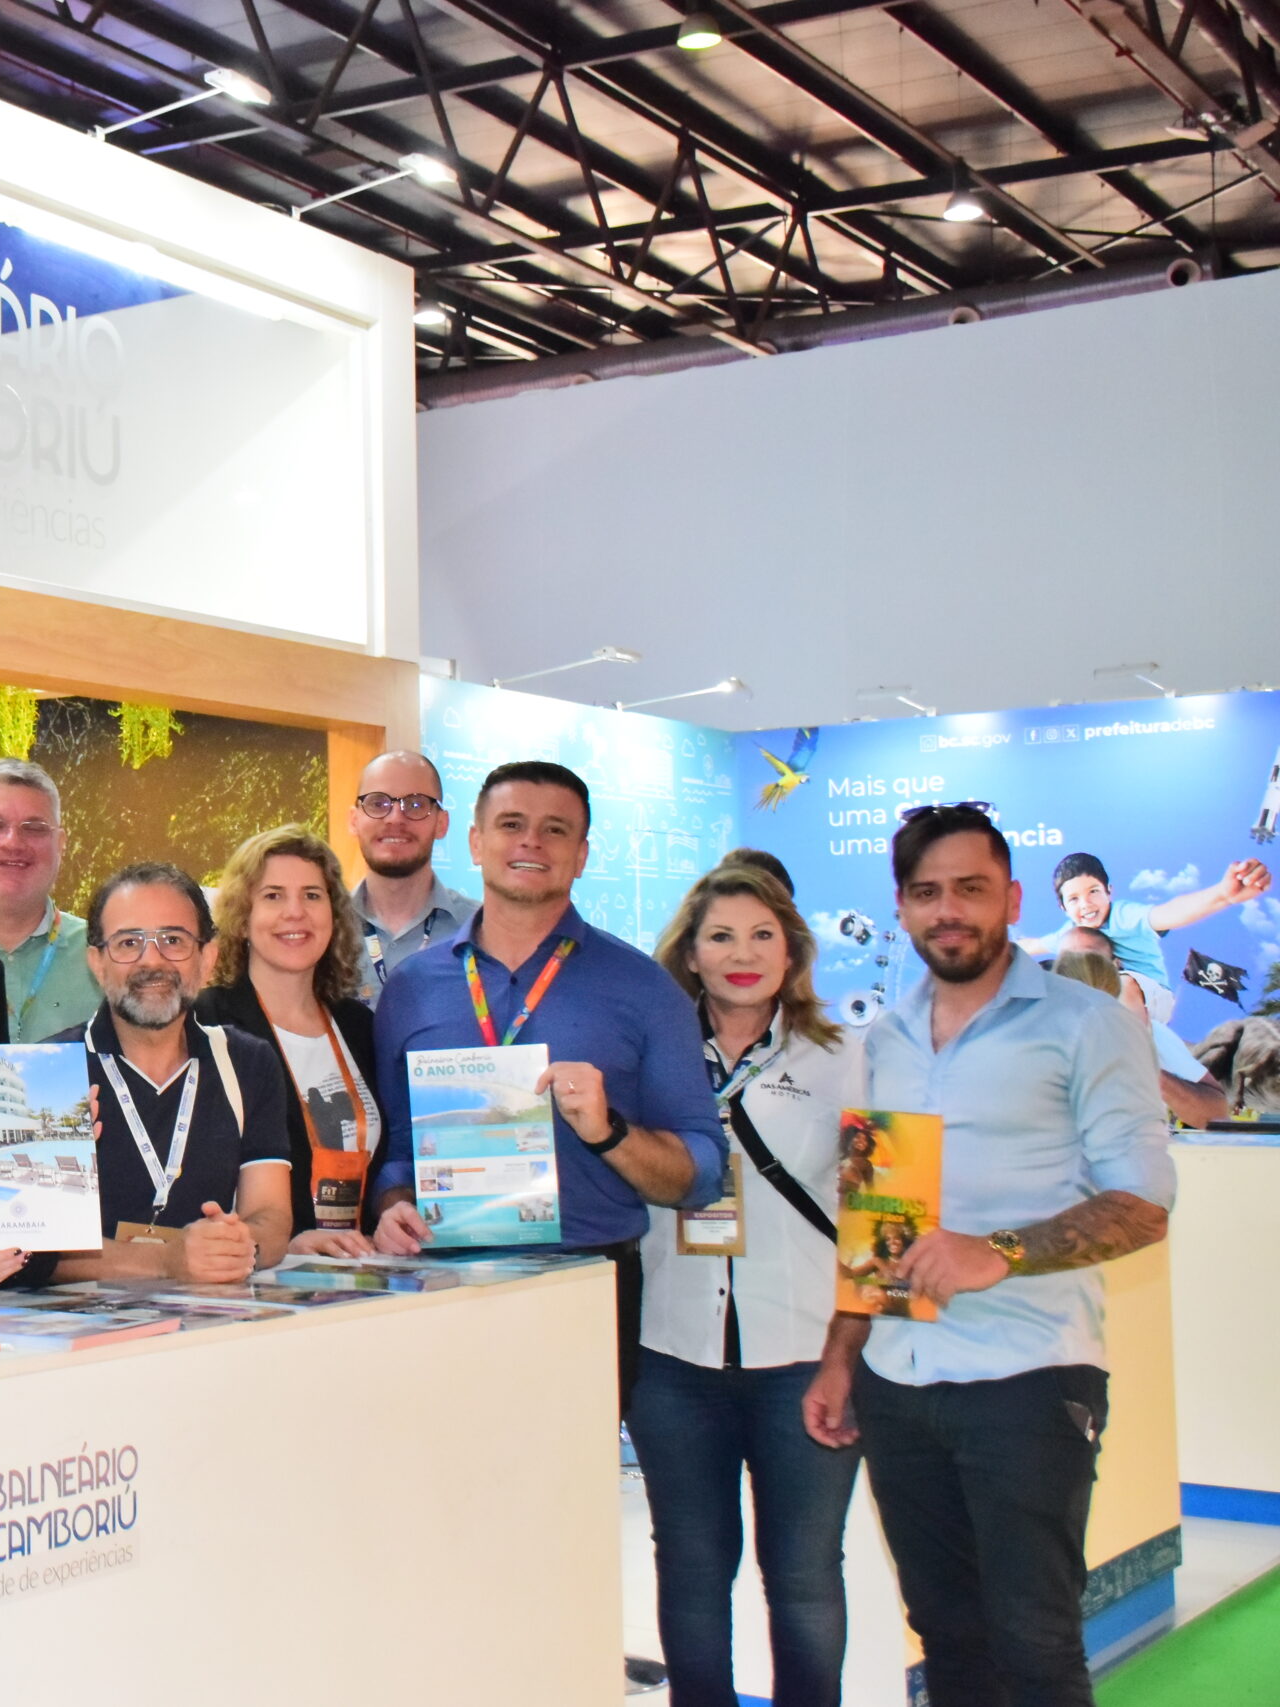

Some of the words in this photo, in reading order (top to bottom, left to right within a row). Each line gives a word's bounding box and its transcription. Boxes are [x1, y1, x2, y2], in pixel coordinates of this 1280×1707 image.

[1084, 716, 1216, 740] prefeituradebc
[828, 775, 887, 798] Mais
[892, 774, 945, 798] que
[828, 808, 887, 827] uma
[829, 837, 888, 856] uma
[413, 1066, 423, 1077] O
[426, 1065, 456, 1077] ANO
[459, 1062, 496, 1075] TODO
[18, 1566, 40, 1593] de
[42, 1543, 134, 1590] experiências
